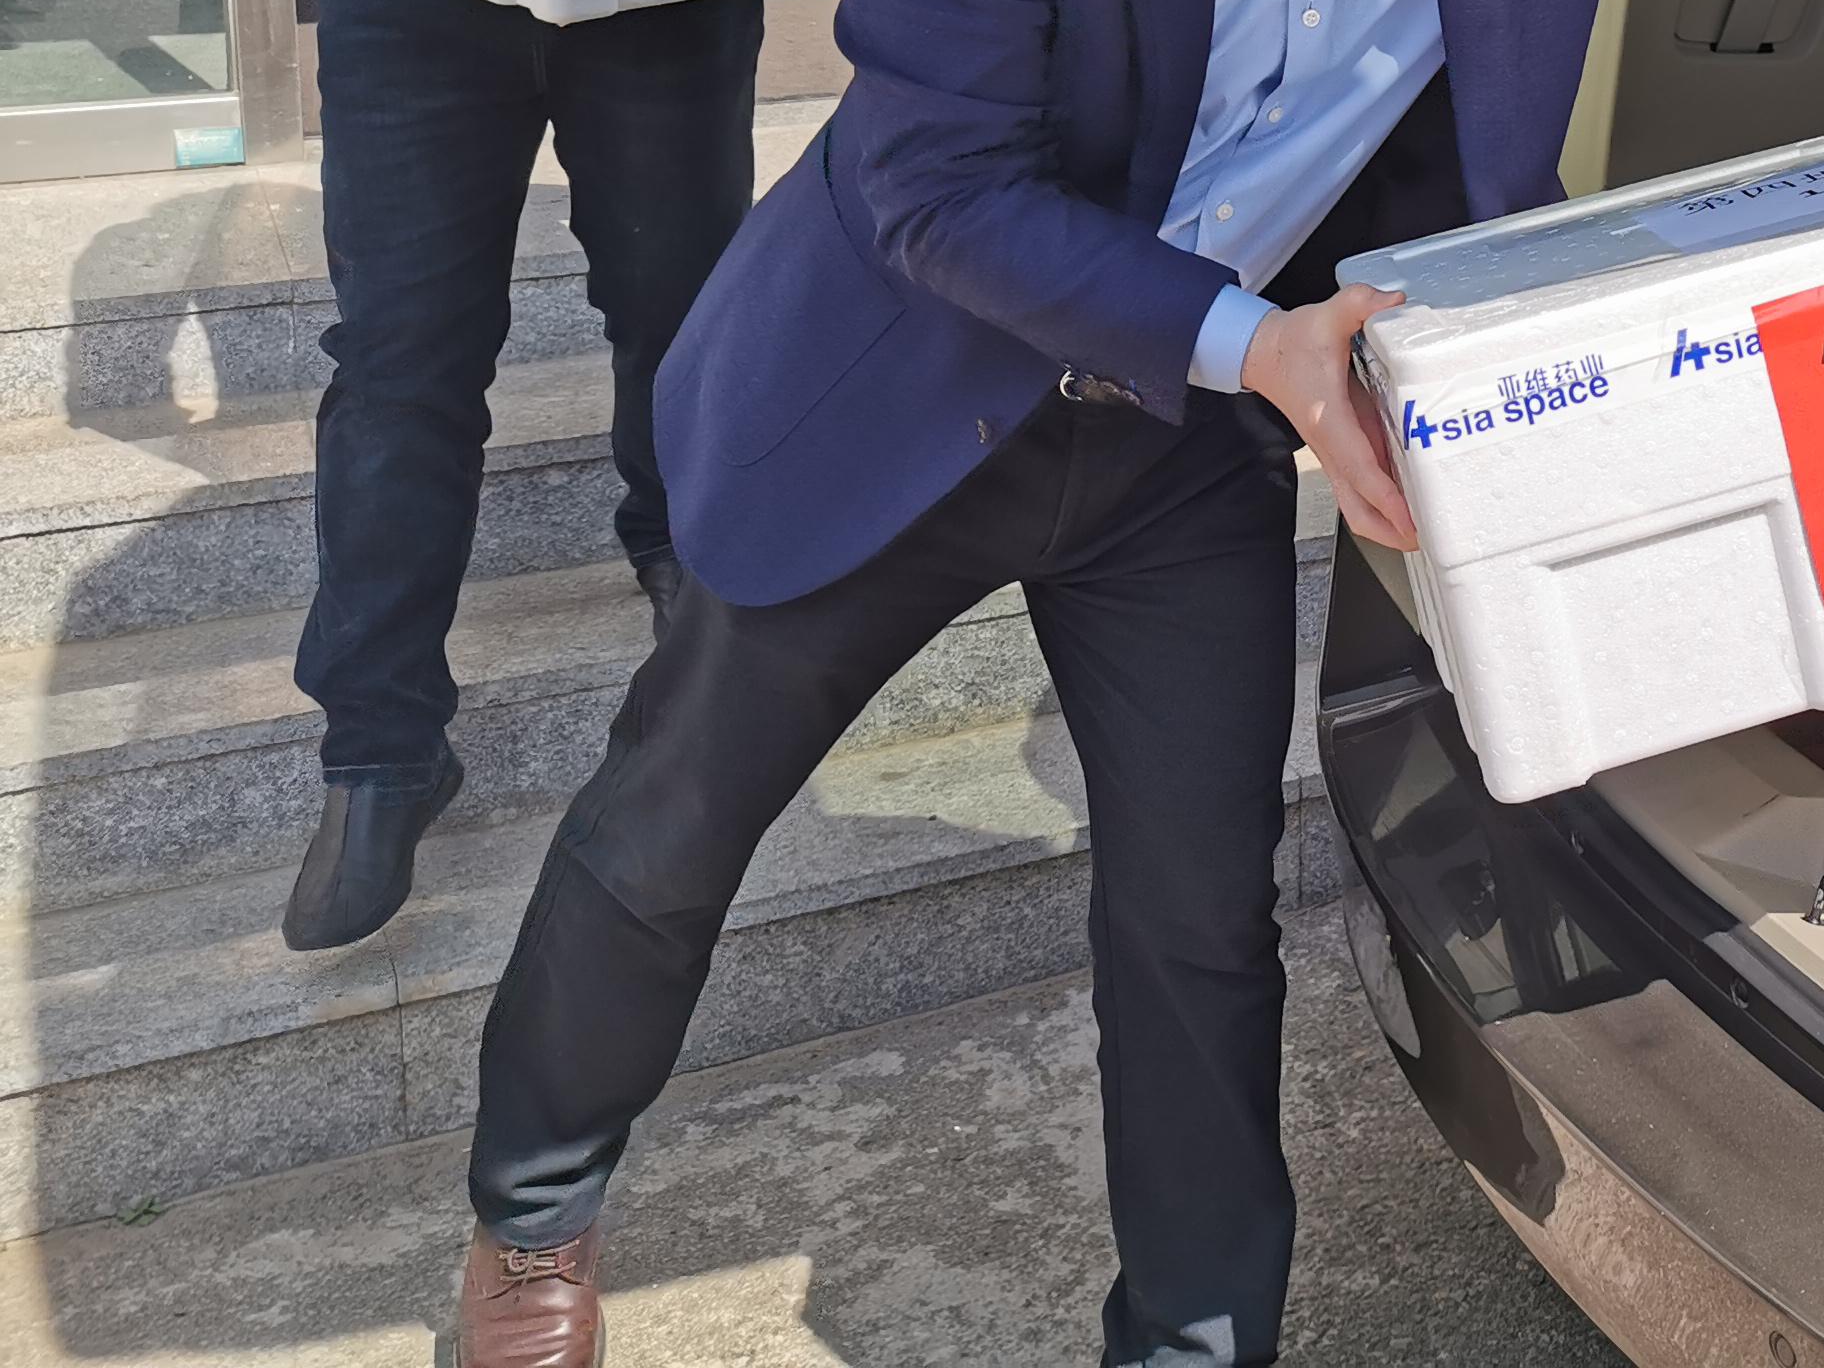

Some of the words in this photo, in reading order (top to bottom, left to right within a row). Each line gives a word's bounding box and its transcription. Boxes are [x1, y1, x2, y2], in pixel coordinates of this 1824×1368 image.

[1497, 353, 1604, 400] 亚维药业
[1669, 328, 1763, 379] Asia
[1402, 399, 1495, 451] Asia
[1502, 374, 1611, 425] space
